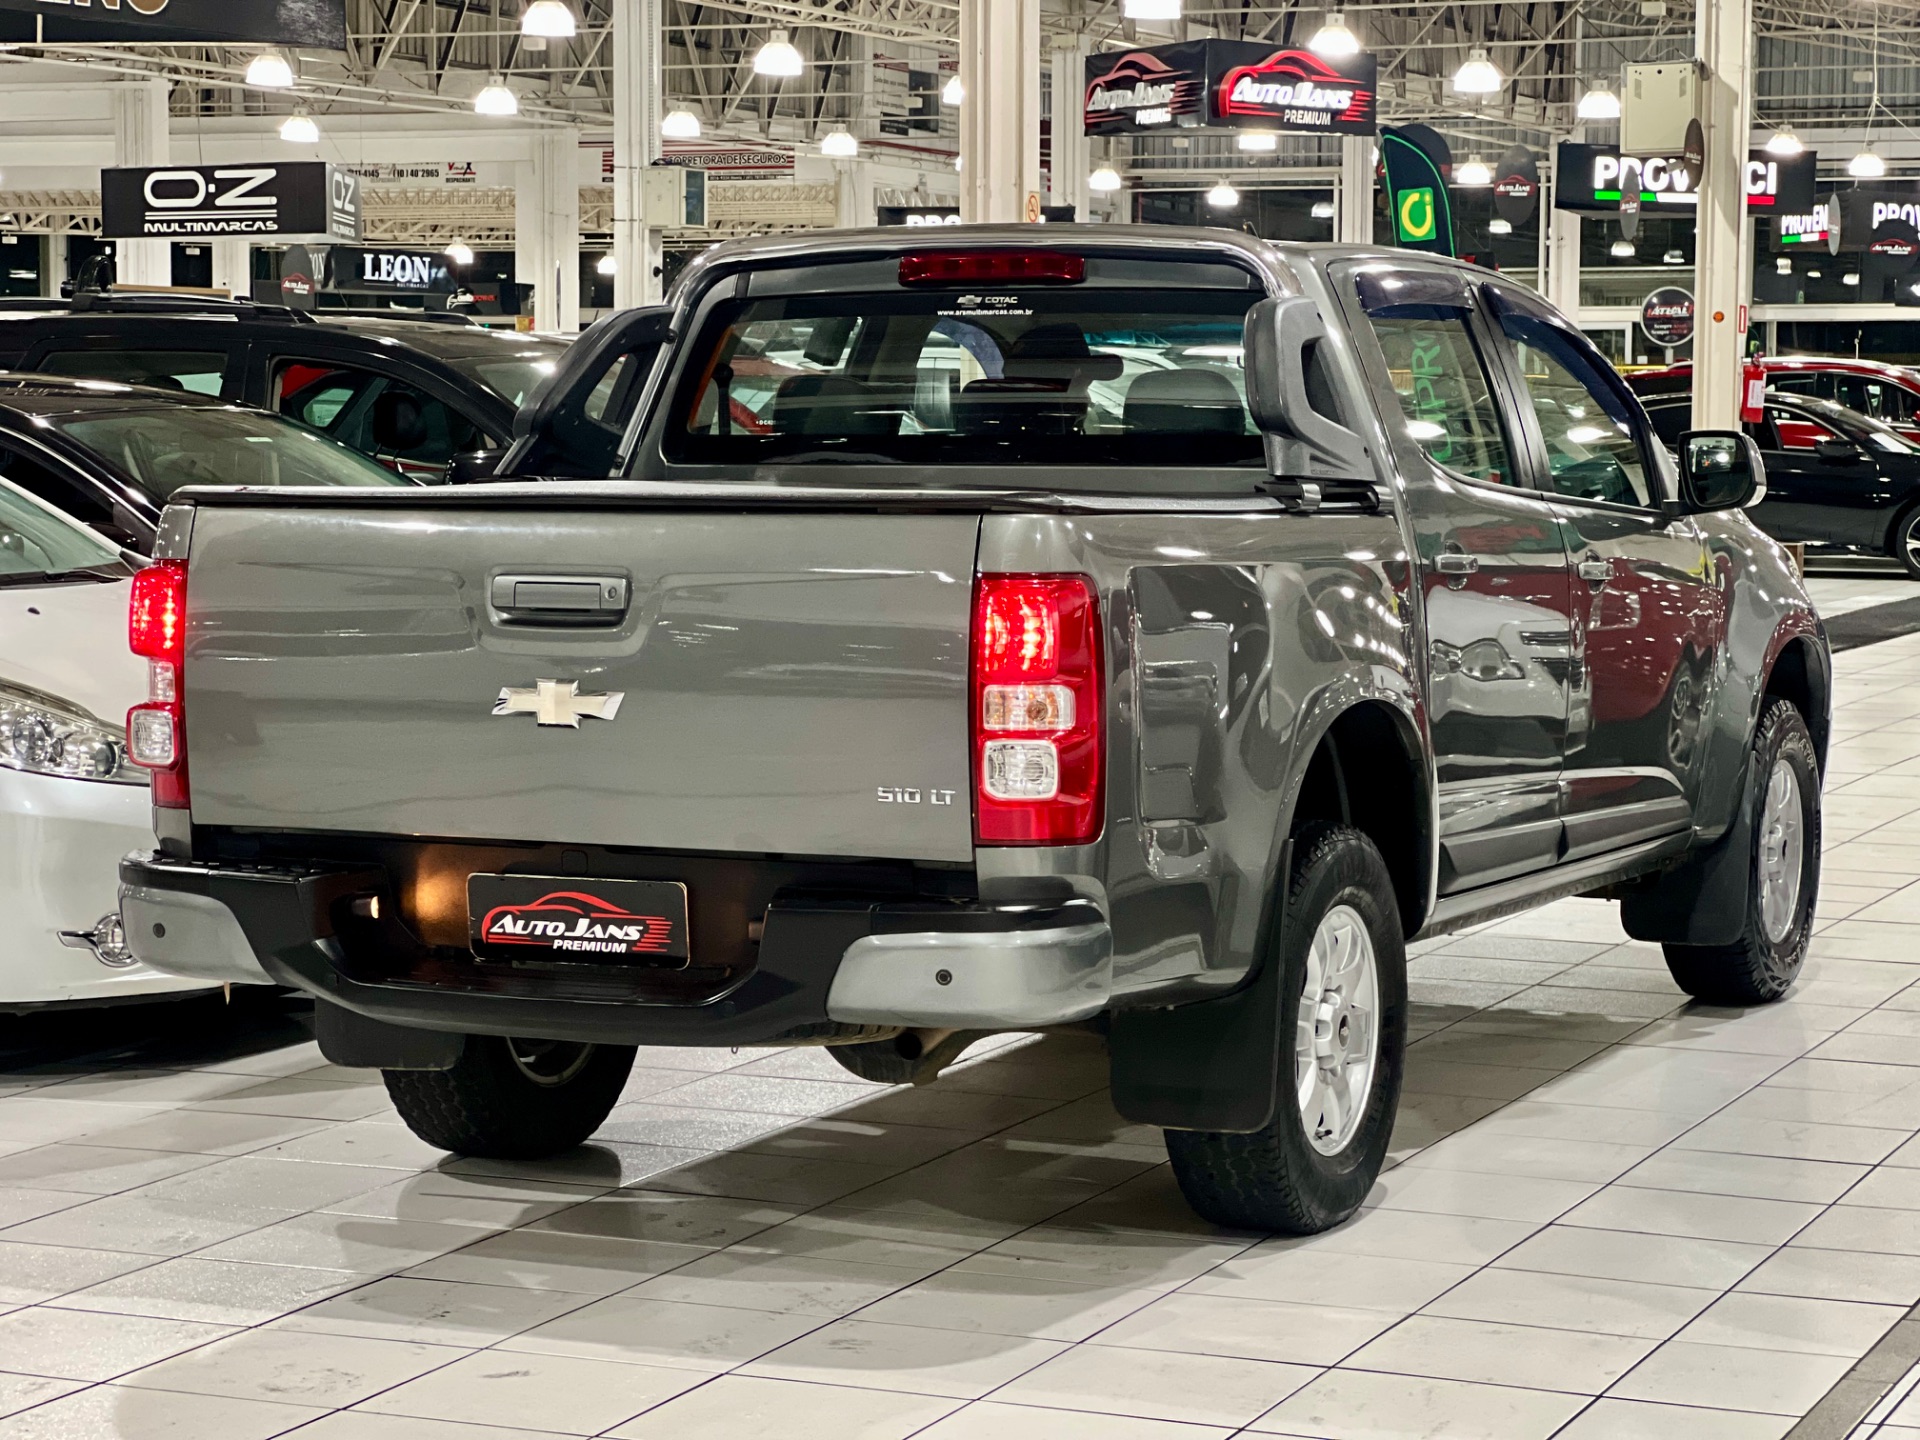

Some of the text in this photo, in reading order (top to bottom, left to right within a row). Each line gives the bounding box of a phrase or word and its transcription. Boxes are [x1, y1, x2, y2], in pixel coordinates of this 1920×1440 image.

[1136, 107, 1172, 125] PREMIUM
[1283, 109, 1331, 125] PREMIUM
[726, 154, 739, 165] DE
[741, 154, 787, 165] SEGUROS
[144, 220, 279, 233] MULTIMARCAS
[363, 253, 431, 283] LEON
[877, 787, 956, 805] S10 LT
[552, 939, 627, 954] PREMIUM
